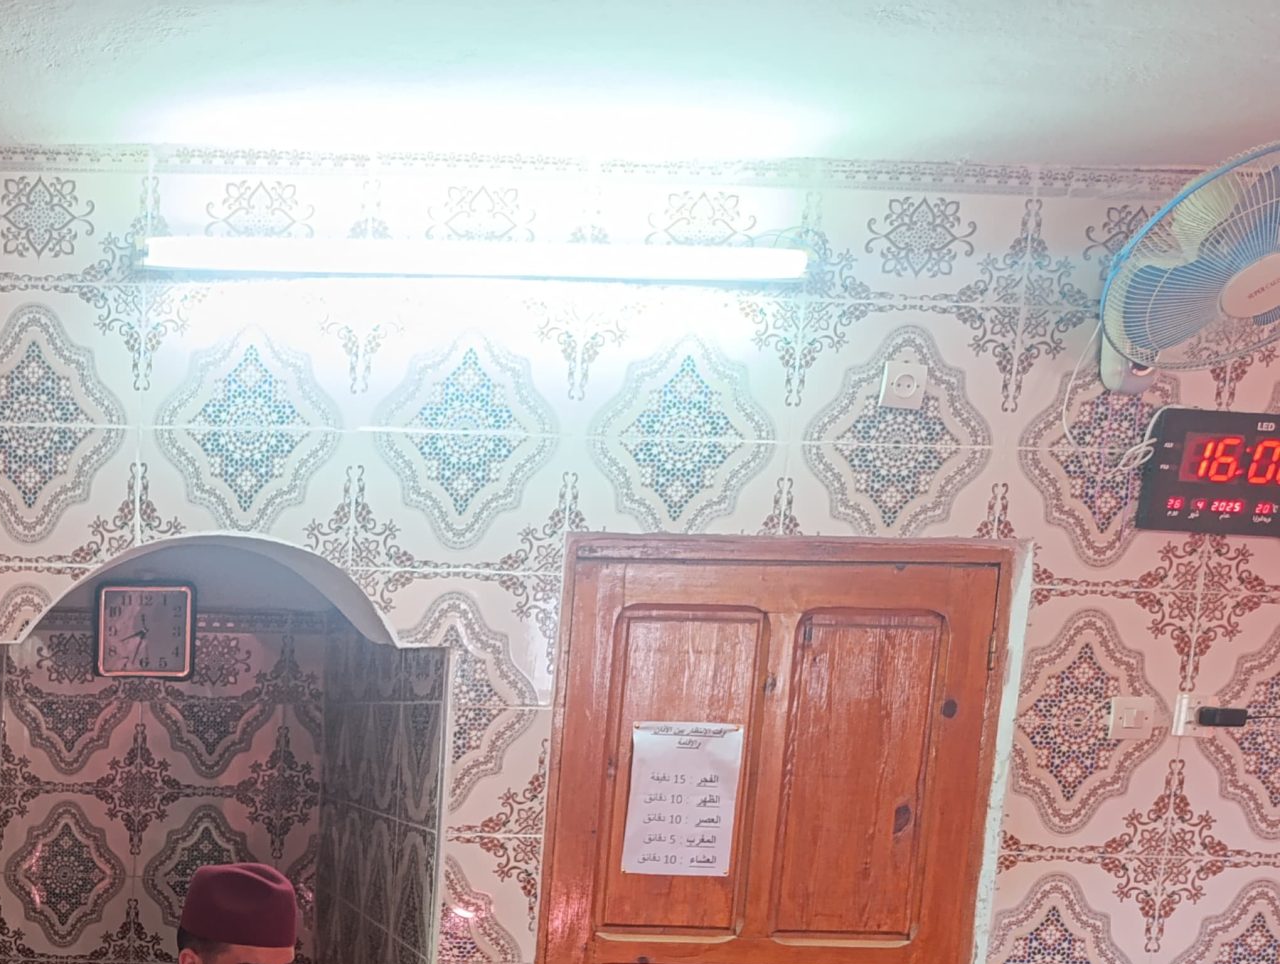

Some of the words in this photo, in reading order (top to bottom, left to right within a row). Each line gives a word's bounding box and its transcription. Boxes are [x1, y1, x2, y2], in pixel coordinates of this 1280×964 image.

[1257, 422, 1275, 431] LED
[1198, 436, 1280, 485] 16:0
[1211, 501, 1242, 512] 2025
[674, 774, 686, 784] 15
[697, 774, 719, 787] الفجر
[671, 794, 682, 804] 10
[697, 794, 720, 807] الظهر
[669, 814, 682, 825] 10
[695, 815, 721, 827] العصر
[669, 834, 676, 844] 5
[686, 835, 716, 847] المغرب
[664, 854, 677, 865] 10
[689, 855, 717, 864] العشاء
